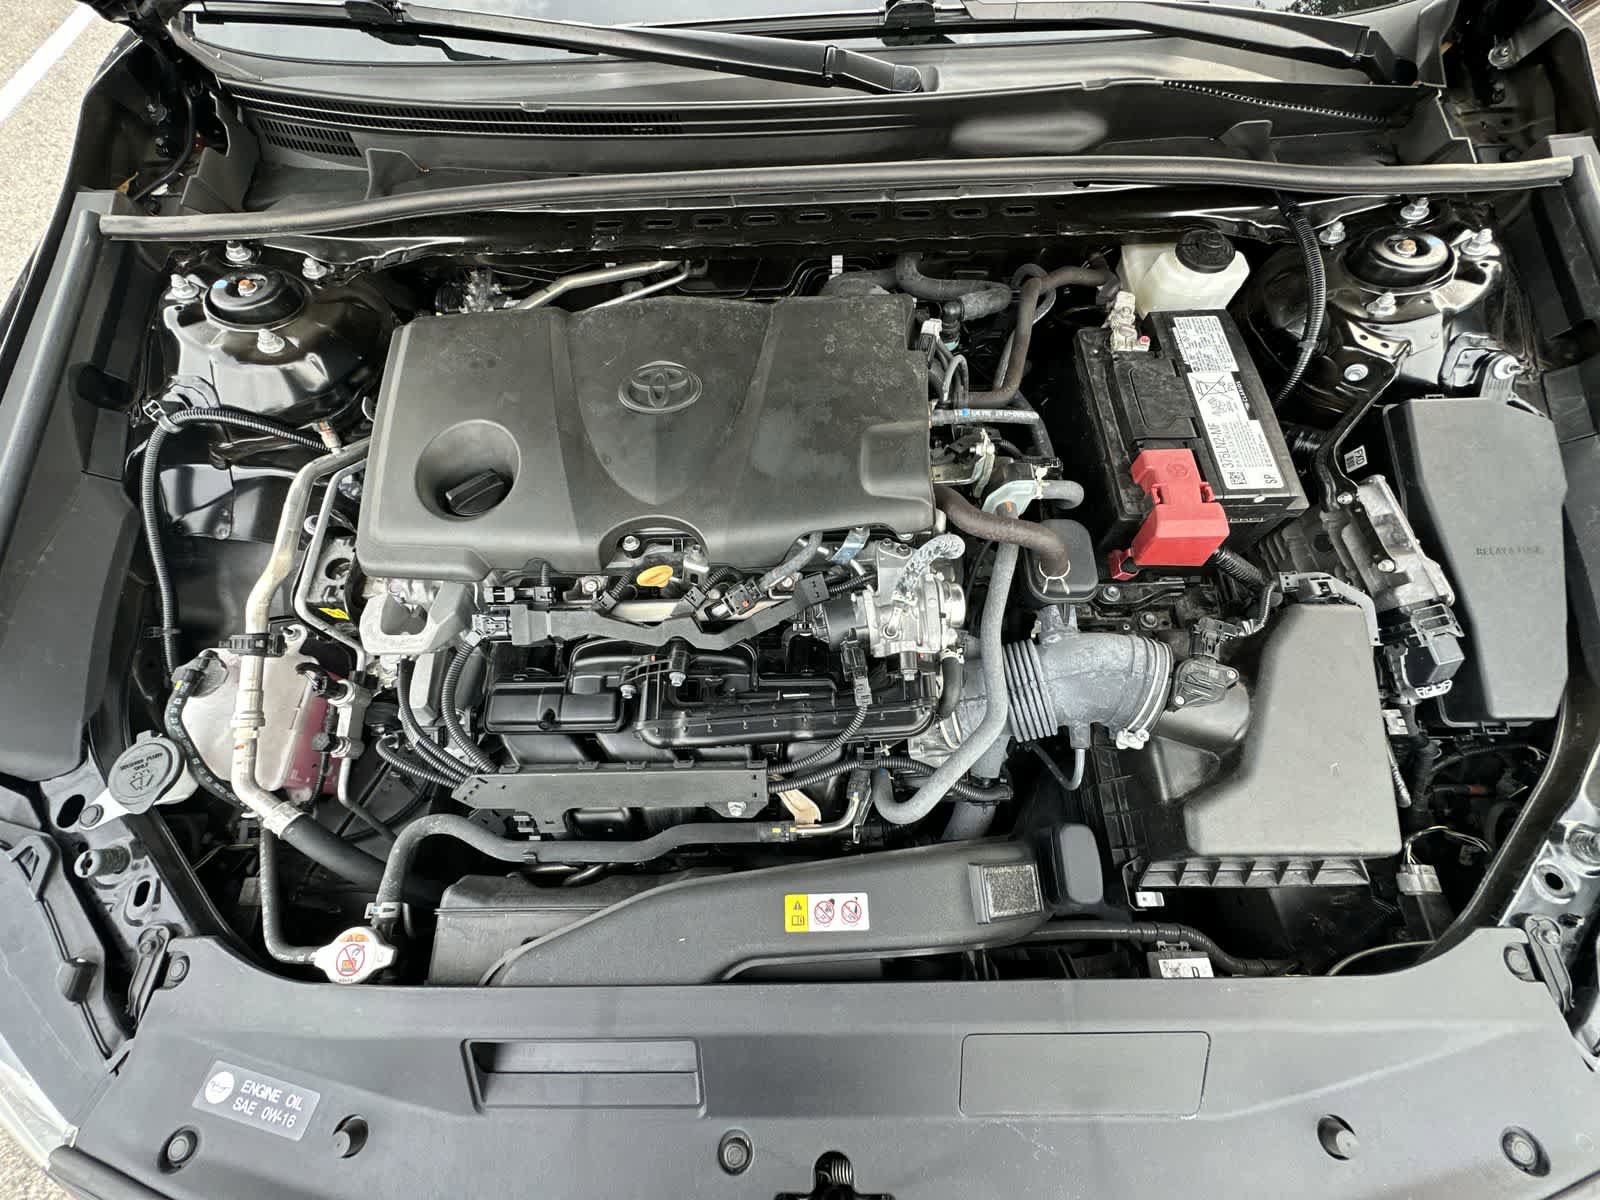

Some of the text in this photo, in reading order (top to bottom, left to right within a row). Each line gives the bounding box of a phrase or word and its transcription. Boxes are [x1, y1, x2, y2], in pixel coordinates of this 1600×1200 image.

[1476, 546, 1506, 555] RELAY
[240, 1080, 282, 1103] ENGINE
[285, 1093, 304, 1111] OIL
[232, 1097, 297, 1128] SAE 0W-16
